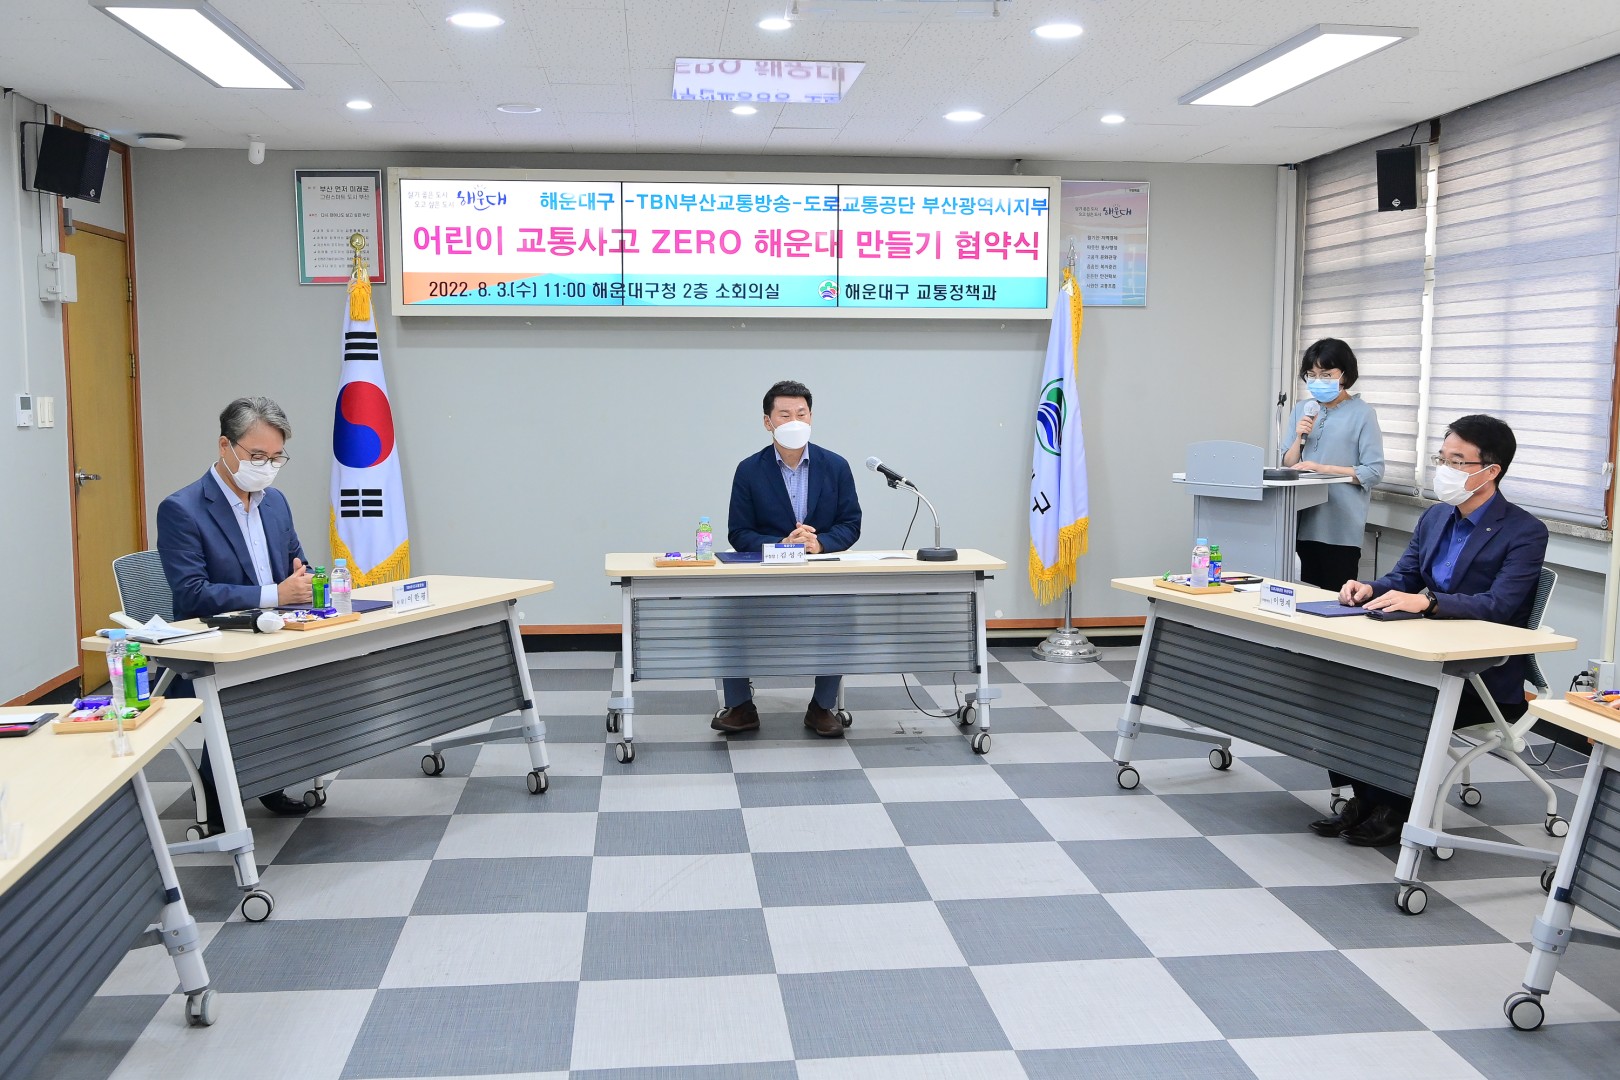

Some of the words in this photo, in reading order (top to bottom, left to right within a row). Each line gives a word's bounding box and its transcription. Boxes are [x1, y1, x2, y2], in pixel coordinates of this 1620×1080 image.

[320, 185, 333, 193] 부산
[349, 185, 370, 193] 미래로
[407, 191, 420, 199] 살기
[456, 189, 507, 211] 해운대
[539, 191, 615, 211] 해운대구
[921, 196, 1049, 217] 부산광역시지부
[1102, 205, 1132, 219] 해운대
[413, 225, 503, 256] 어린이
[516, 226, 640, 257] 교통사고
[651, 228, 742, 255] ZERO
[754, 228, 844, 259] 해운대
[856, 230, 941, 259] 만들기
[955, 230, 1039, 260] 협약식
[429, 281, 473, 298] 2022.
[477, 281, 492, 298] 8.
[496, 281, 537, 299] 3.(수)
[543, 282, 586, 298] 11:00
[592, 282, 676, 299] 해운대구청
[683, 282, 709, 300] 2층
[715, 283, 780, 300] 소회의실
[845, 283, 910, 301] 해운대구
[916, 284, 997, 302] 교통정책과
